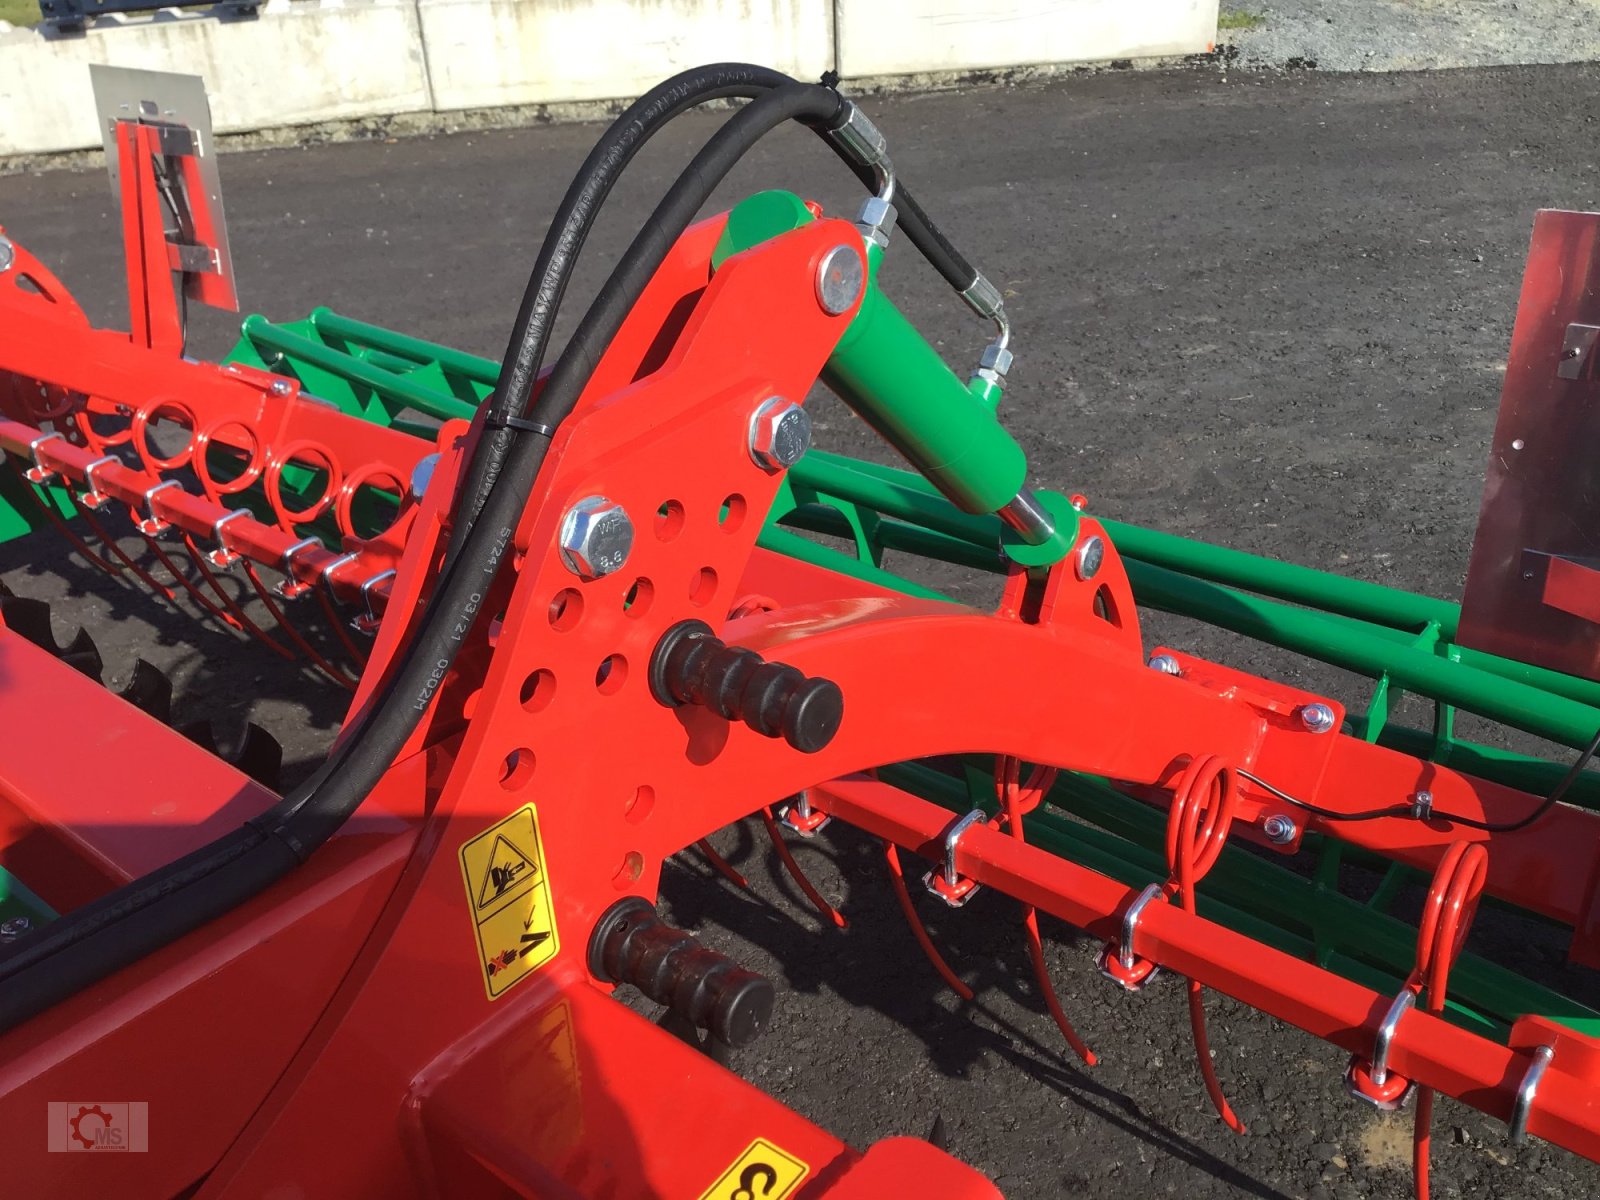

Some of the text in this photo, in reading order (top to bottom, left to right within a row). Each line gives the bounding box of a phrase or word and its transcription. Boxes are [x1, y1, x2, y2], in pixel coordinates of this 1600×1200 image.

[414, 527, 512, 711] 57241 03/21 0302M
